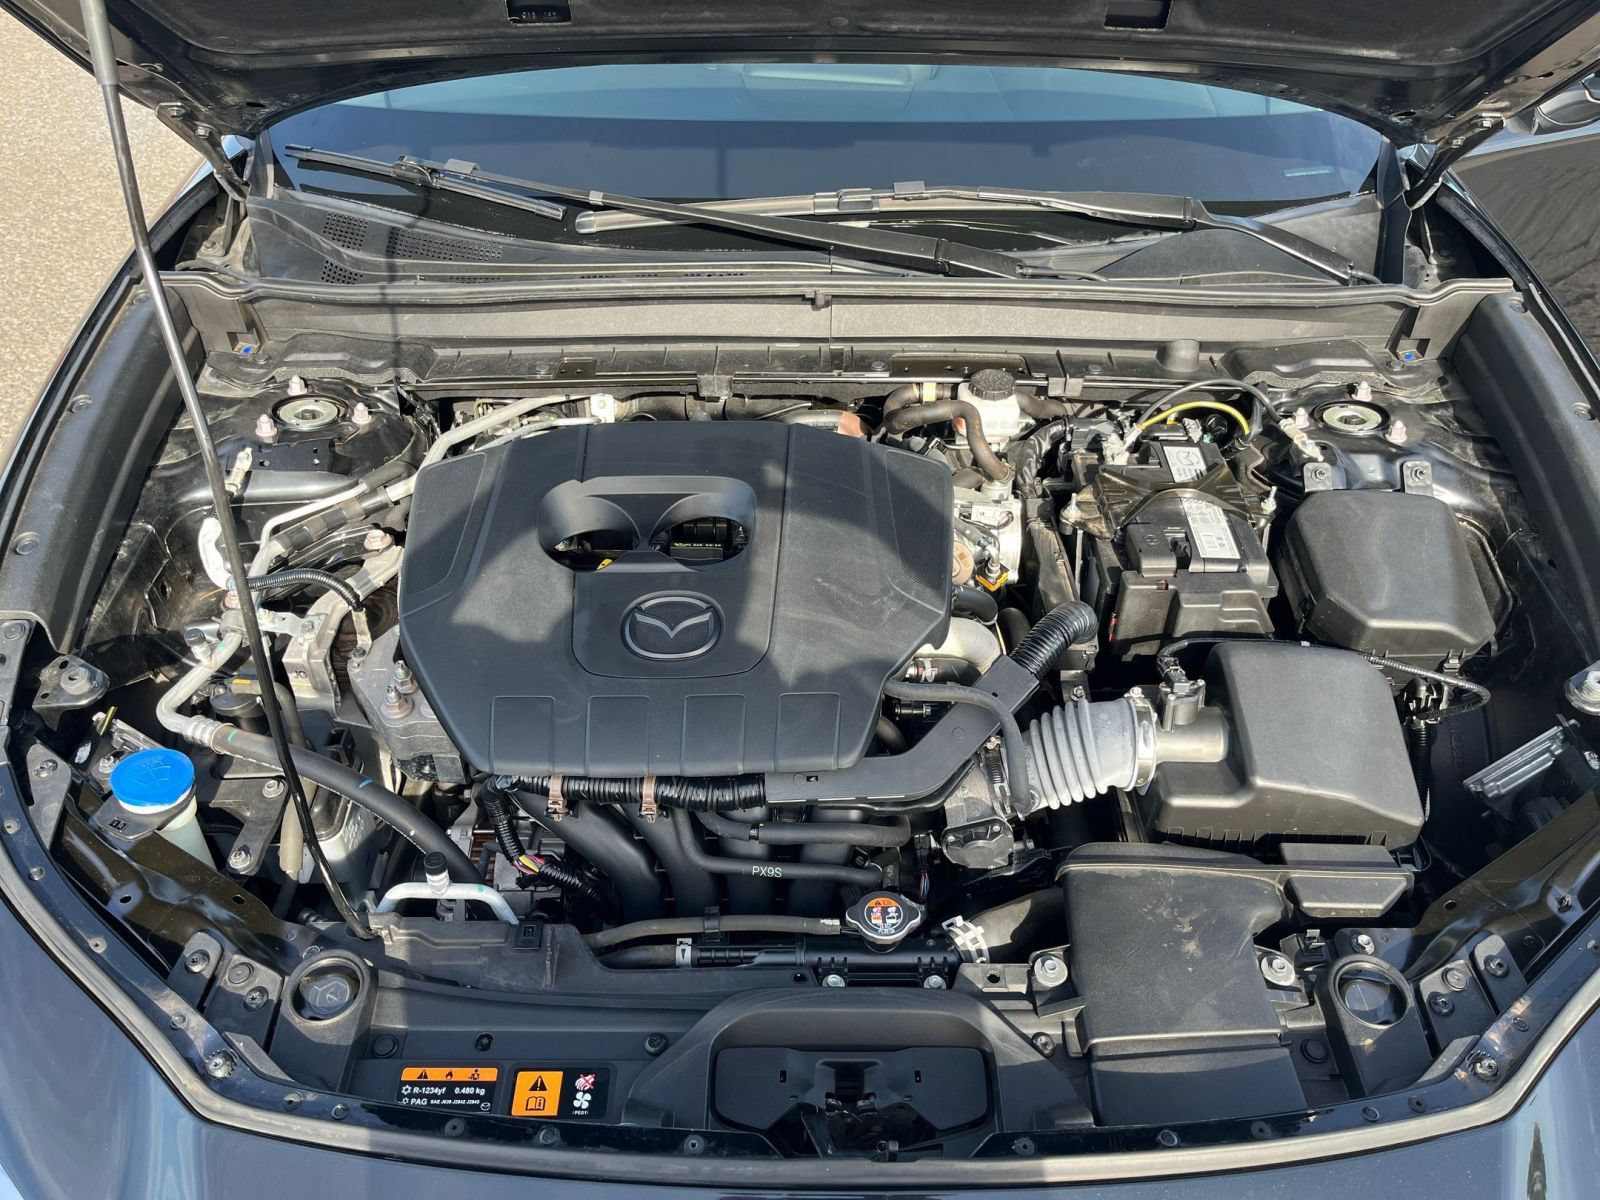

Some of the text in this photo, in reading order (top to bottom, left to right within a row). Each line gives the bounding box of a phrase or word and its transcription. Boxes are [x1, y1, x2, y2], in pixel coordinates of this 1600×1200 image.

[752, 865, 782, 878] PX9S
[413, 1087, 486, 1096] R-1234yf 0.480 kg
[410, 1098, 427, 1106] PAG
